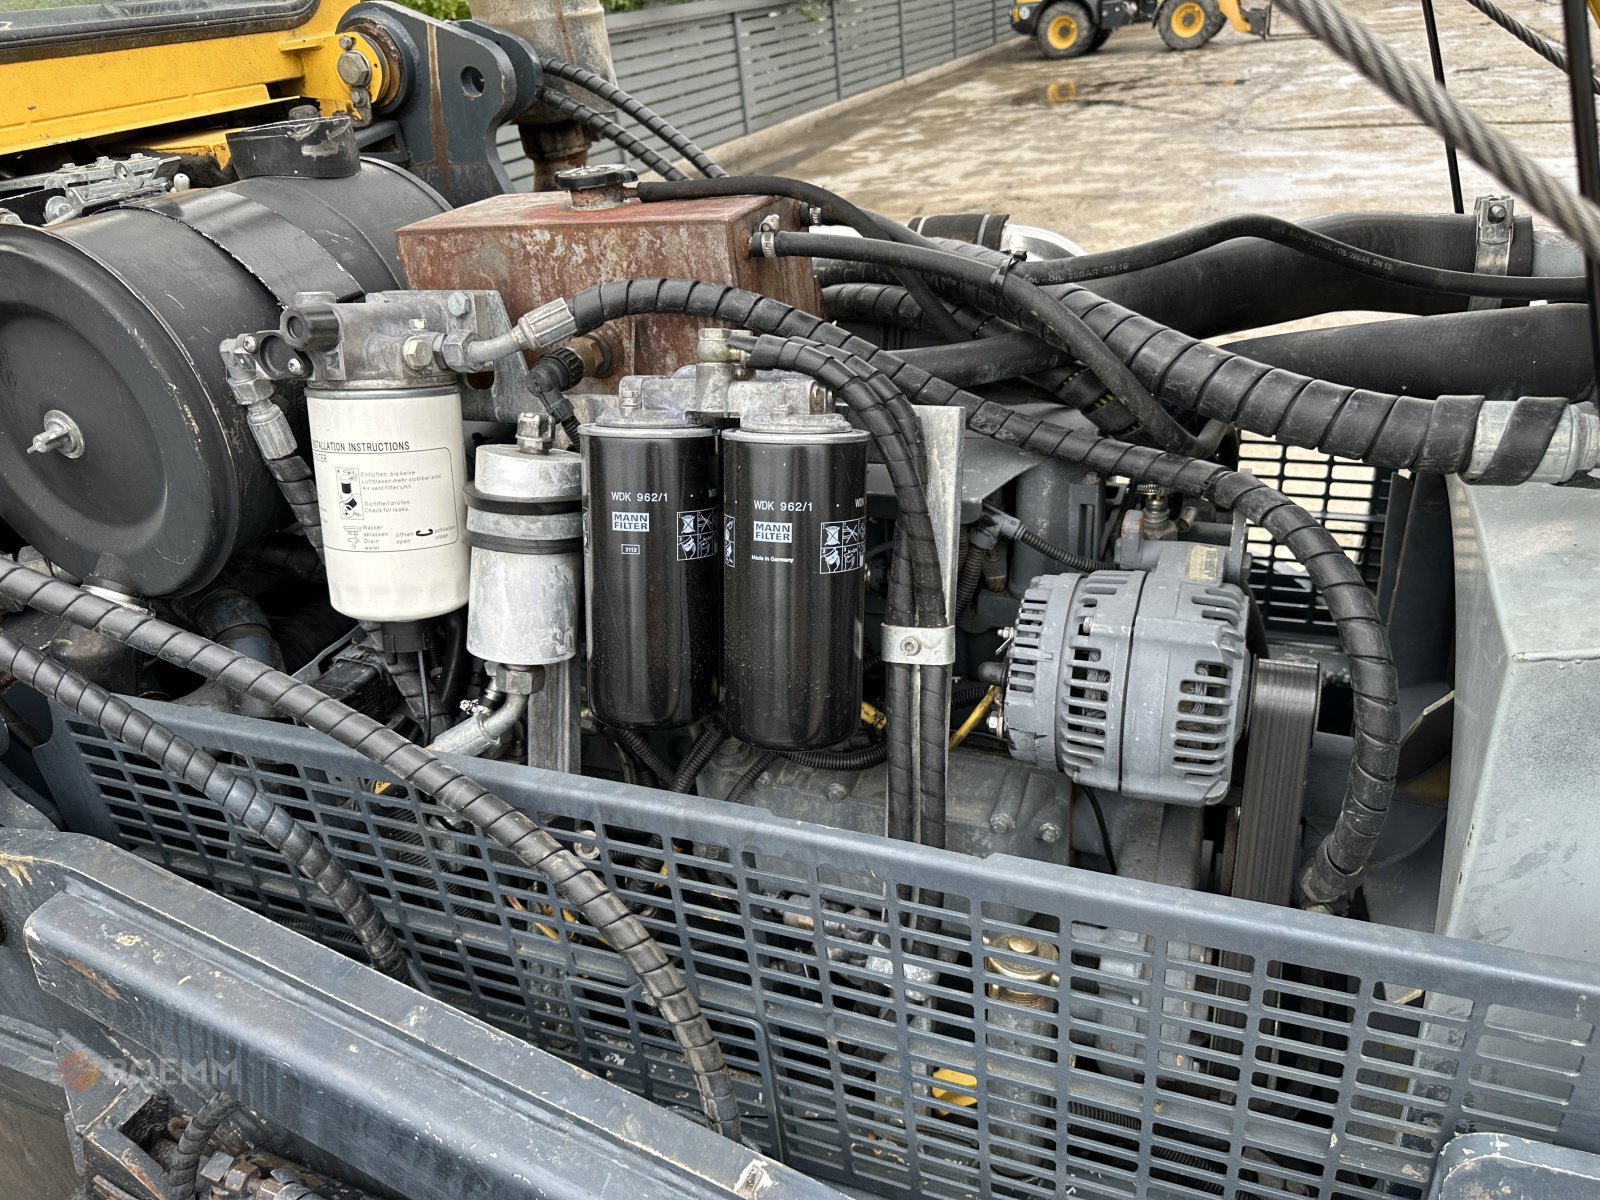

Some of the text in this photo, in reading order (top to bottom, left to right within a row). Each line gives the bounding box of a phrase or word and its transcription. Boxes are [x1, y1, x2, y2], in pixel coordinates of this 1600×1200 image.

[1372, 259, 1383, 268] DN
[1103, 265, 1116, 274] DN
[348, 441, 410, 452] INSTRUCTIONS
[611, 491, 668, 502] WDK 962/1
[753, 500, 813, 512] WDK 962/1
[614, 513, 648, 522] MANN
[614, 521, 648, 530] FILTER
[755, 523, 790, 533] MANN
[755, 531, 790, 541] FILTER
[751, 554, 764, 562] Made
[770, 556, 794, 564] Germany
